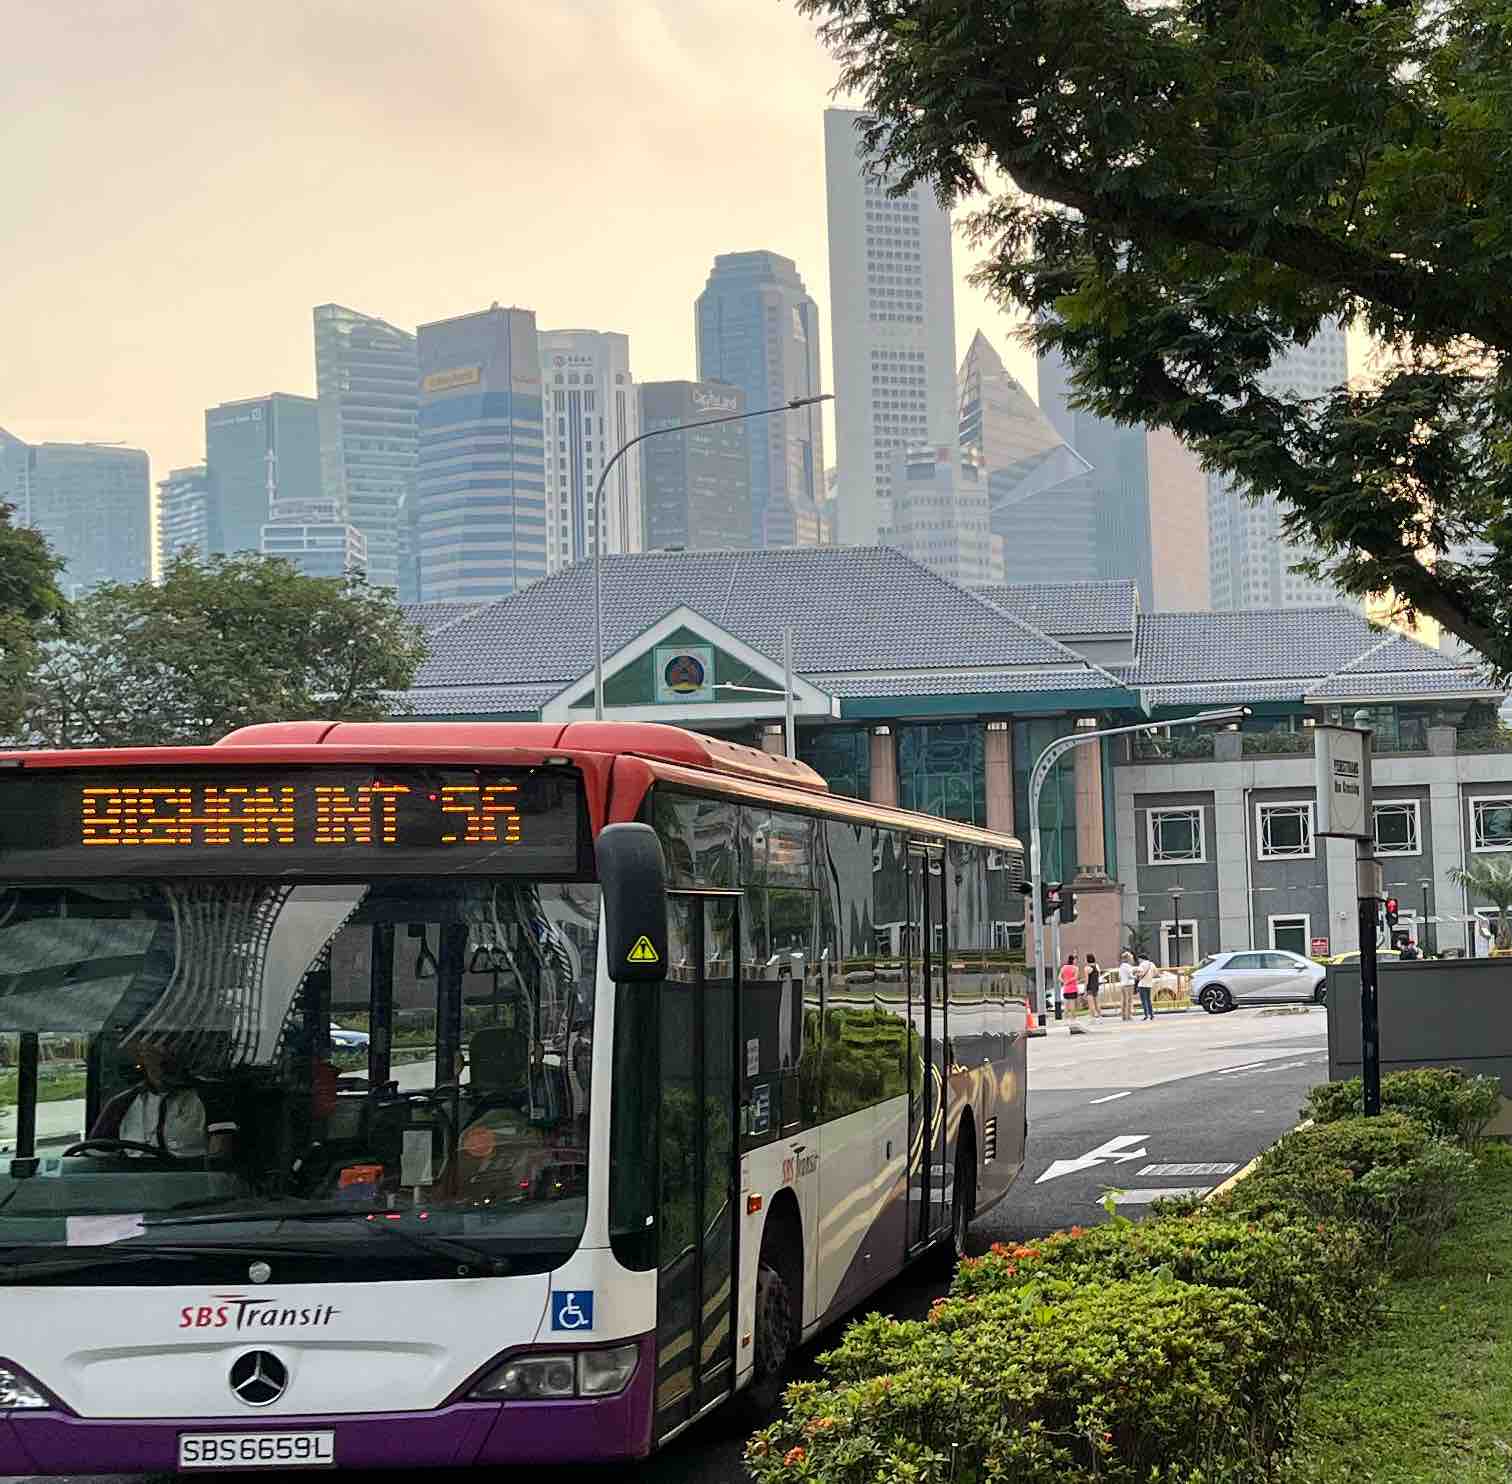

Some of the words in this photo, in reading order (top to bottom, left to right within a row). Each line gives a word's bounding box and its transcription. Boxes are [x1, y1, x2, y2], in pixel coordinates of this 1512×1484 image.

[81, 786, 295, 845] BISHAN
[314, 785, 410, 843] INT
[441, 785, 520, 842] 56
[179, 1306, 229, 1328] SBS
[223, 1299, 342, 1331] Transit
[183, 1437, 331, 1462] SBS6659L
